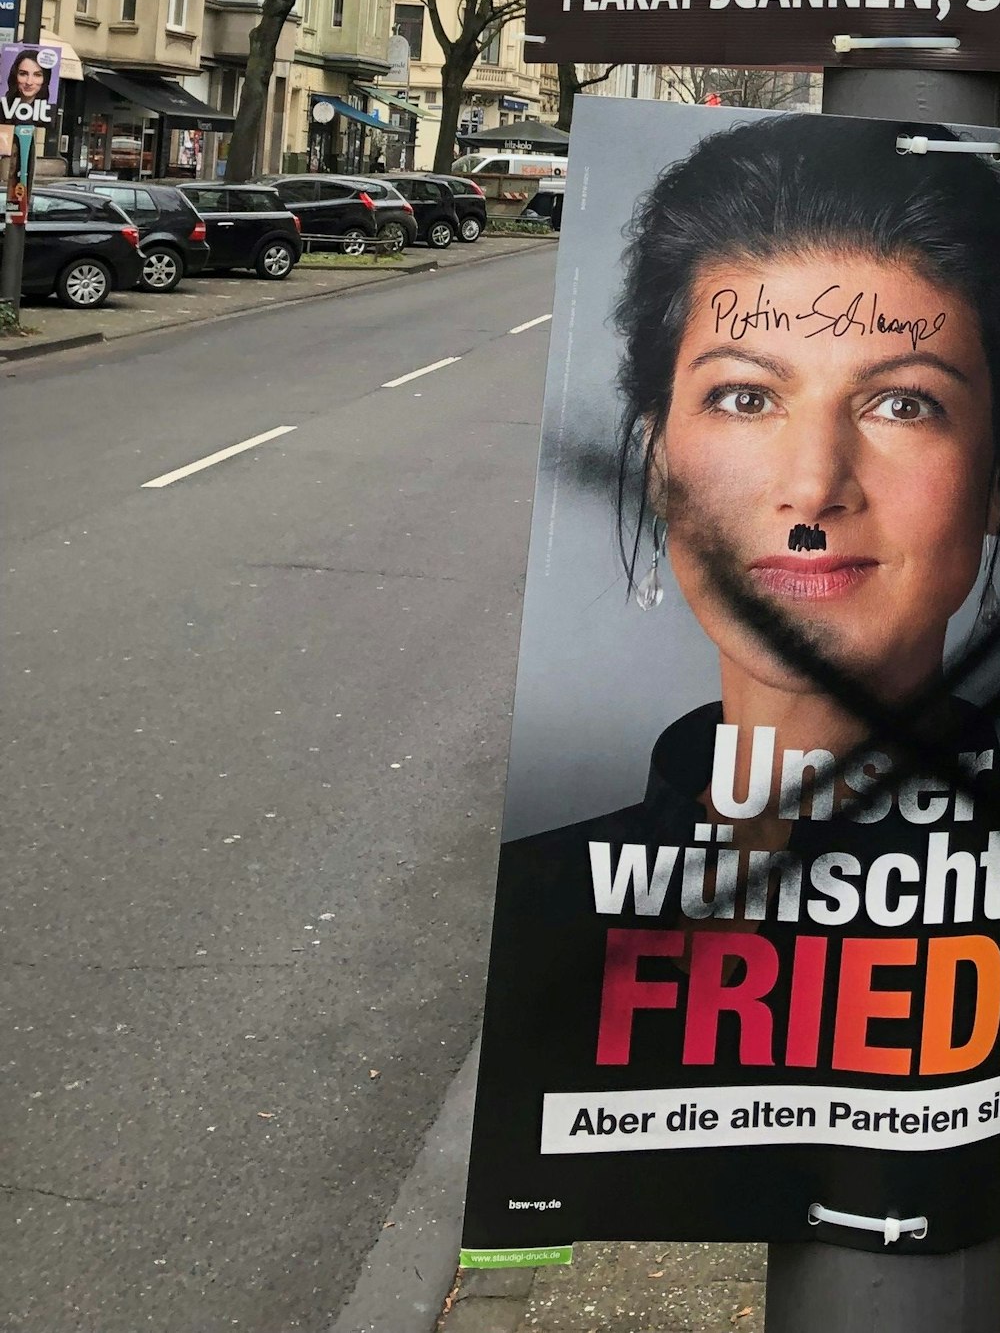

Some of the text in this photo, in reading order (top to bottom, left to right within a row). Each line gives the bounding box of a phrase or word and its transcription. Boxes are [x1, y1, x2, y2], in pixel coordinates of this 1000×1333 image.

[1, 97, 52, 123] Volt
[504, 140, 532, 150] fritz-kola
[710, 723, 994, 825] Unser
[568, 1107, 656, 1136] Aber
[666, 1102, 719, 1131] die
[730, 1100, 817, 1129] alten
[828, 1101, 969, 1135] Parteien
[508, 1199, 562, 1211] bsw-vg.de
[470, 1251, 561, 1264] www.staudigl-druck.de
